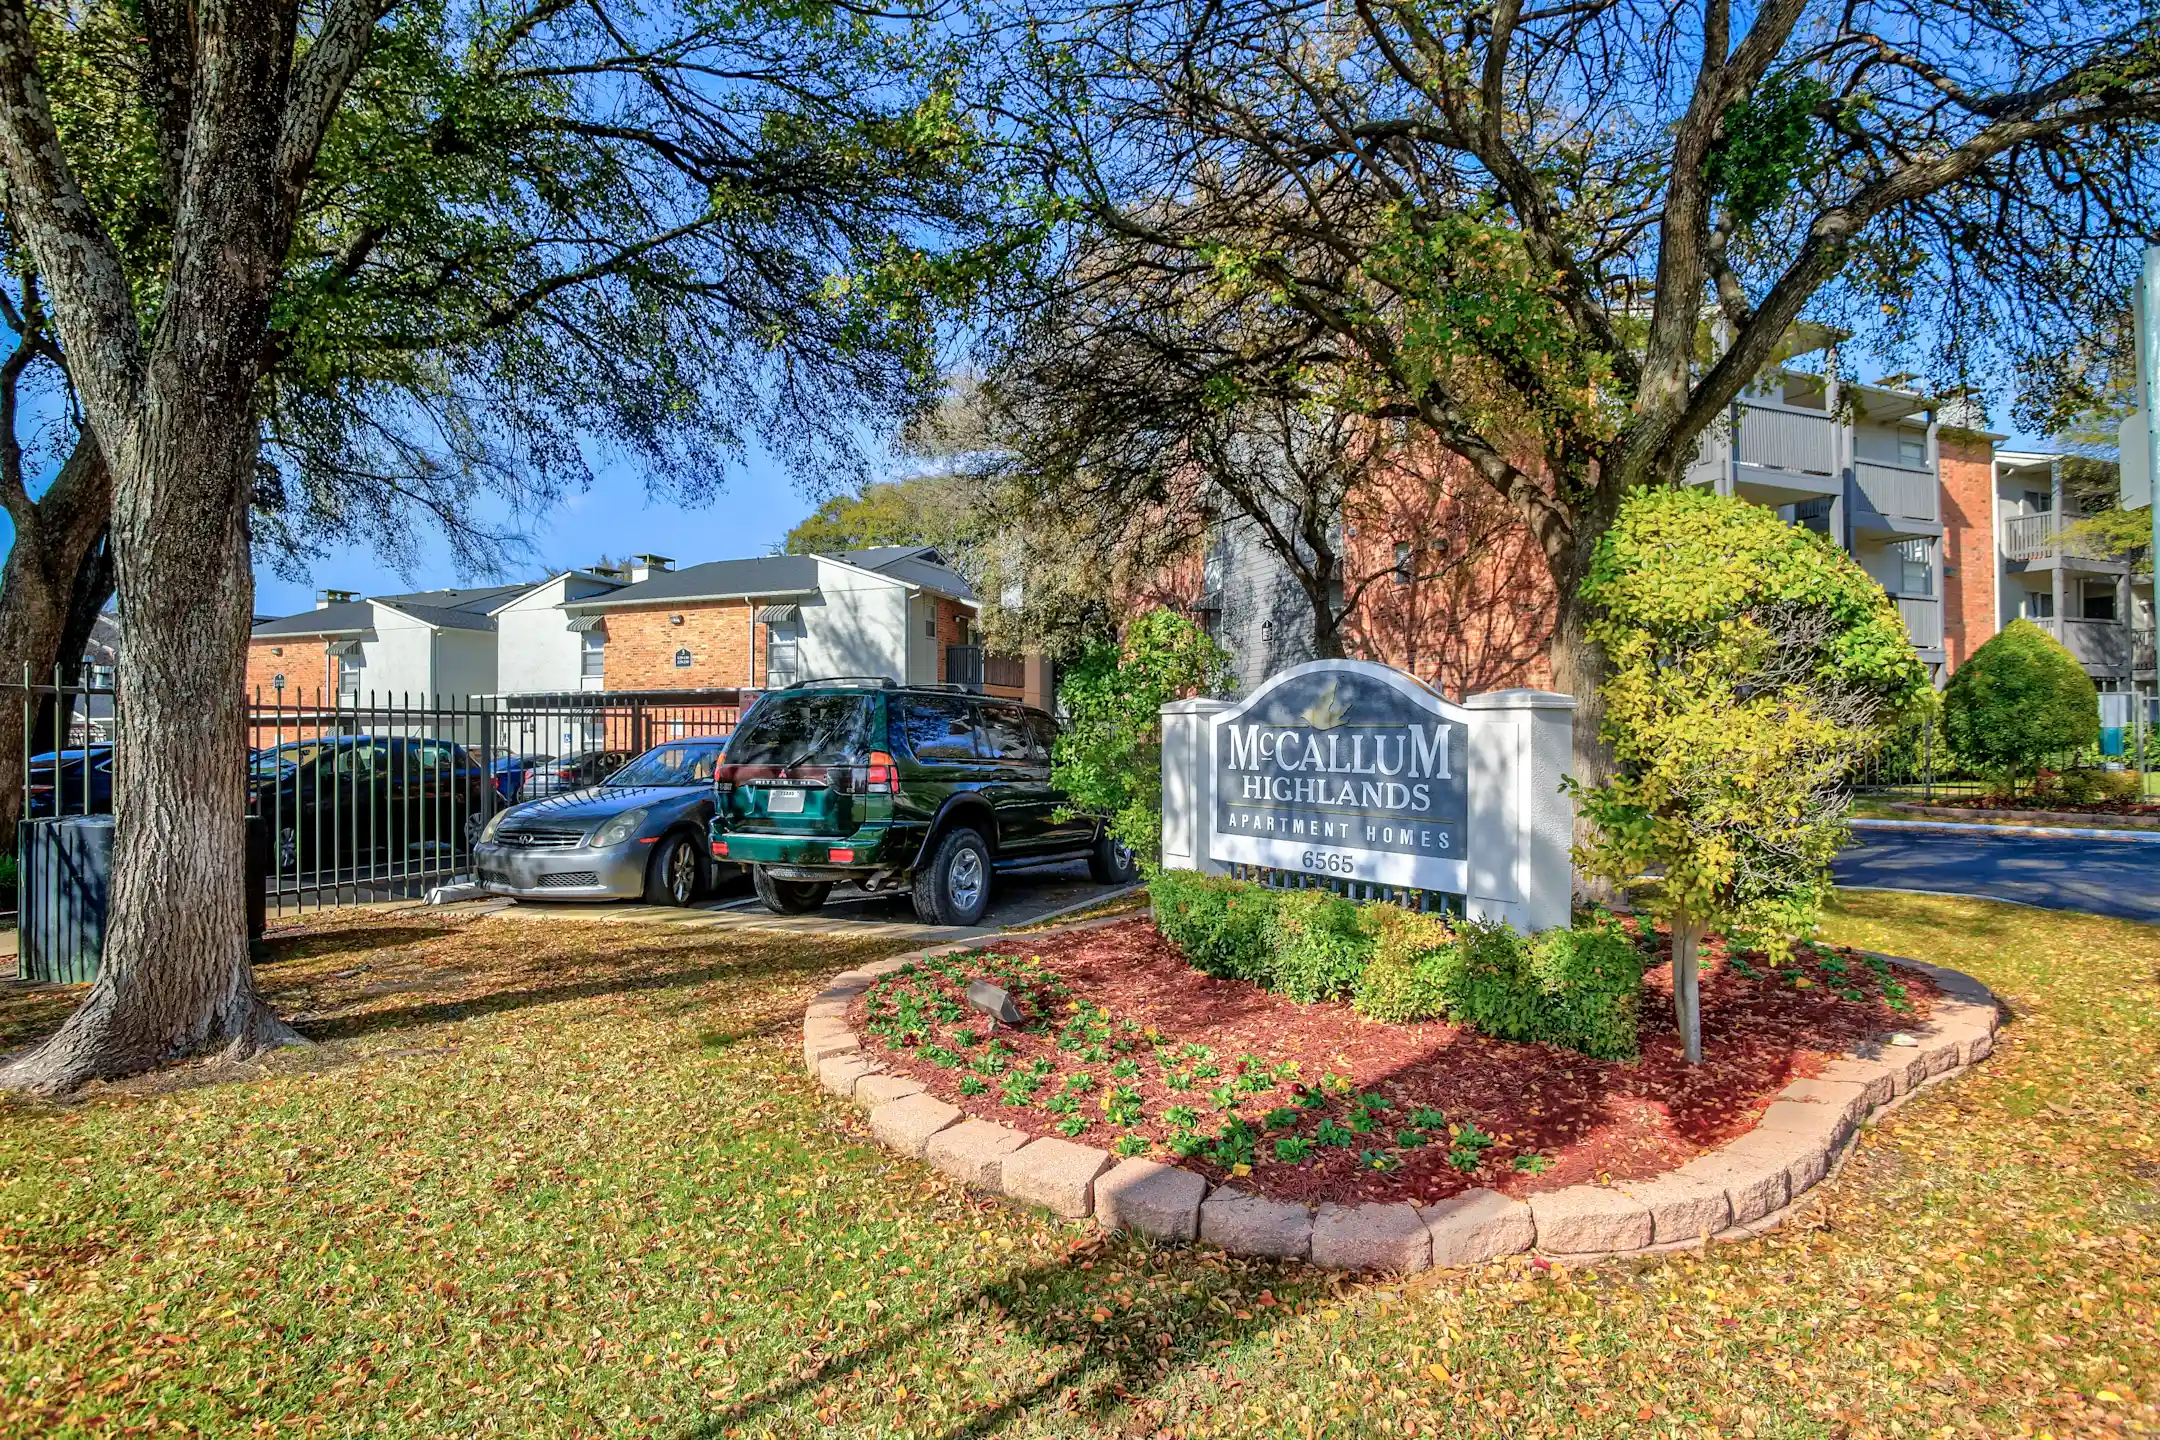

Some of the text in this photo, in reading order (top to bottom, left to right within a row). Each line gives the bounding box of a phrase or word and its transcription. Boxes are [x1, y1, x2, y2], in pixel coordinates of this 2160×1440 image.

[1242, 775, 1431, 812] HIGHLANDS
[1229, 813, 1450, 850] APARTMENT HOMES
[1302, 851, 1354, 873] 6565
